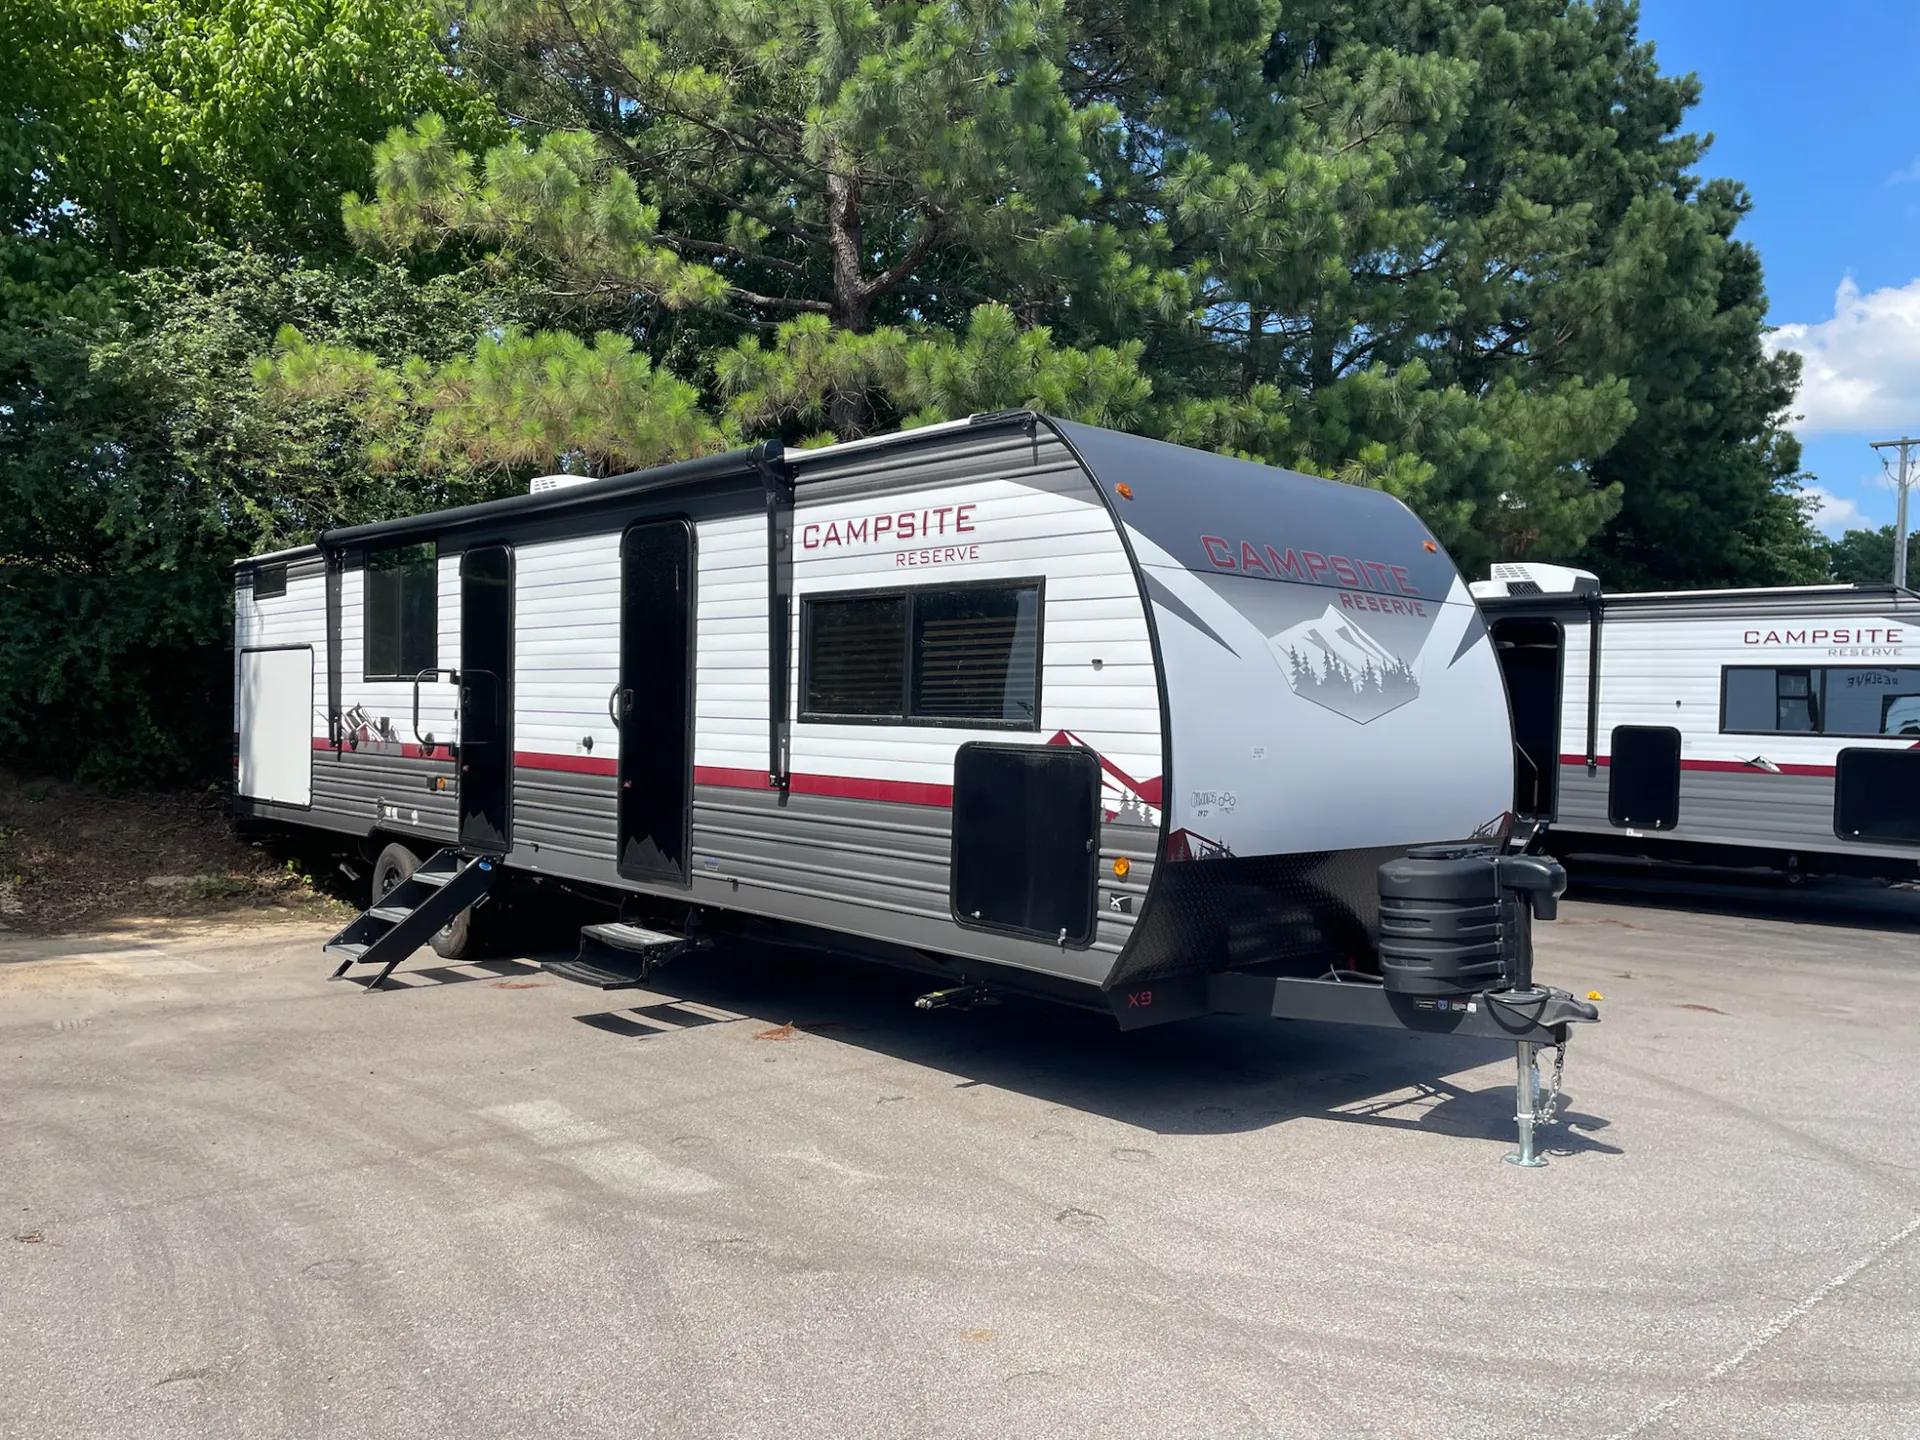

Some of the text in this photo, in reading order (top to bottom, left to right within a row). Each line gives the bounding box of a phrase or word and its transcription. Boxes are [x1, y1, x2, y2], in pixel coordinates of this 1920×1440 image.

[803, 504, 977, 549] CAMPSITE
[896, 545, 980, 567] RESERVE
[1200, 535, 1419, 595] CAMPSITE
[1338, 591, 1428, 618] RESERVE
[1744, 629, 1904, 644] CAMPSITE
[1828, 647, 1903, 657] RESERVE
